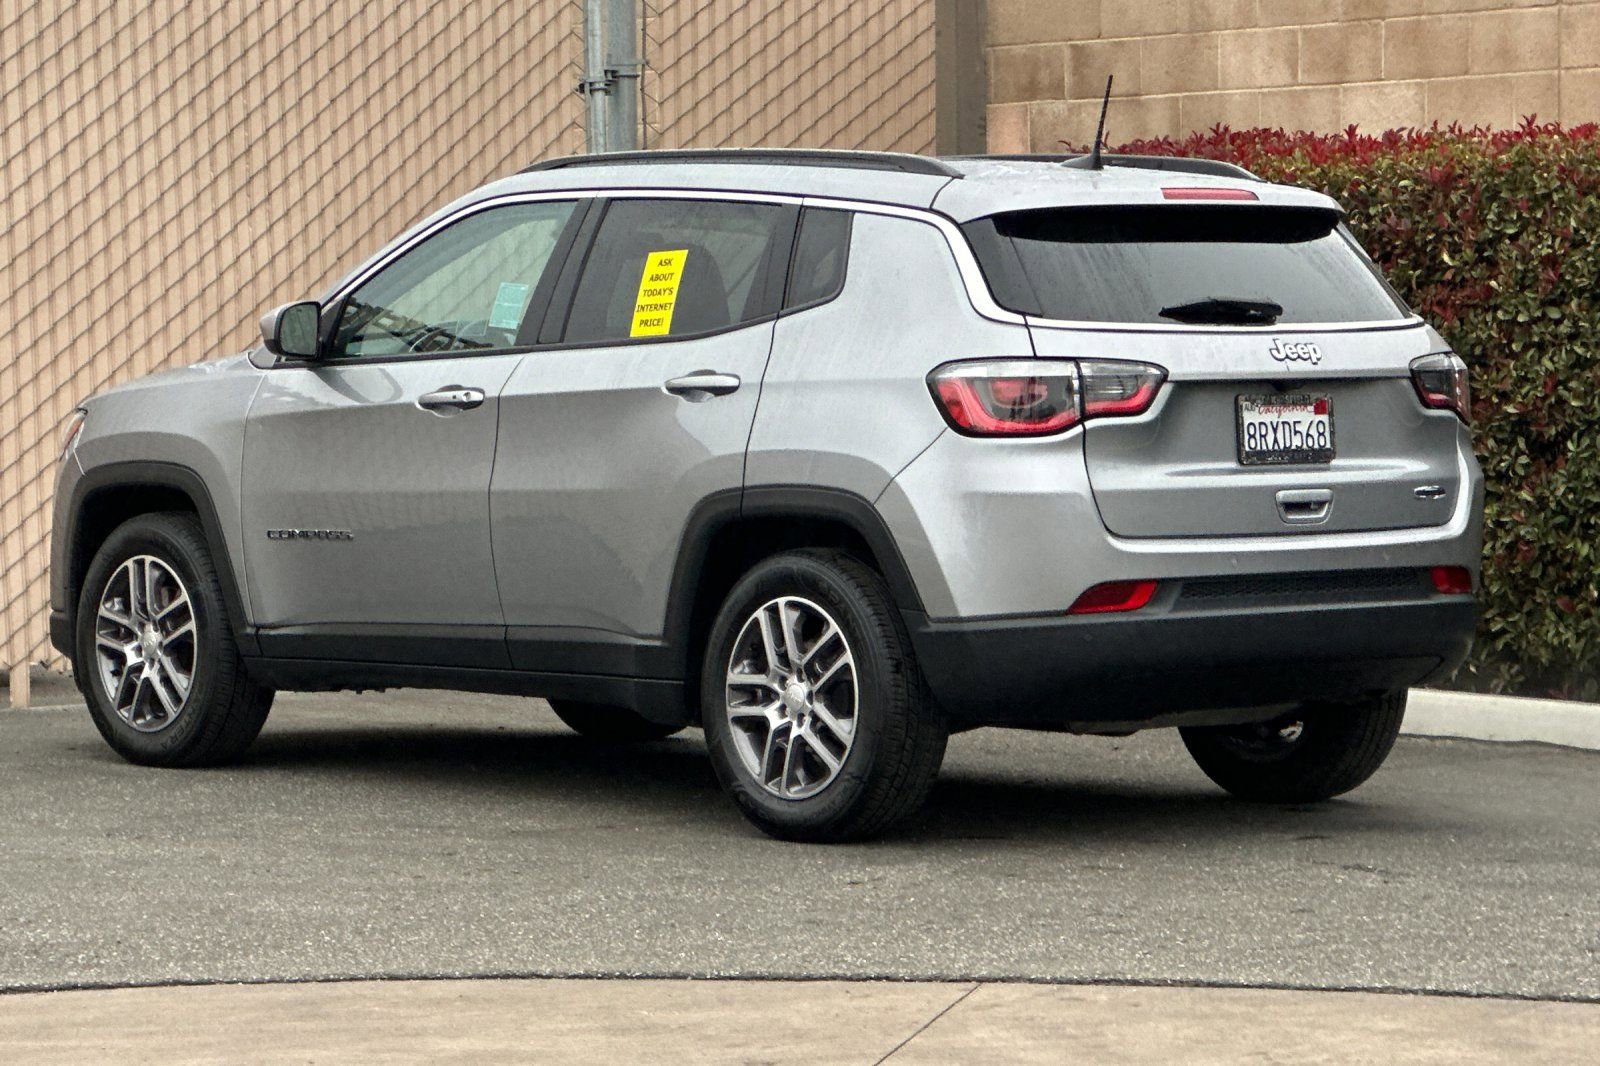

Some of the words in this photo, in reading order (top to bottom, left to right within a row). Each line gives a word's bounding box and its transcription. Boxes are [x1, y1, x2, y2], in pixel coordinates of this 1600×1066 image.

[658, 258, 673, 267] ASK
[649, 273, 674, 282] ABOUT
[643, 287, 673, 297] TODAY'S
[636, 303, 672, 313] INTERNET
[639, 319, 664, 327] PRICE!
[1269, 338, 1322, 365] Jeep
[1247, 420, 1327, 450] 8RXD568
